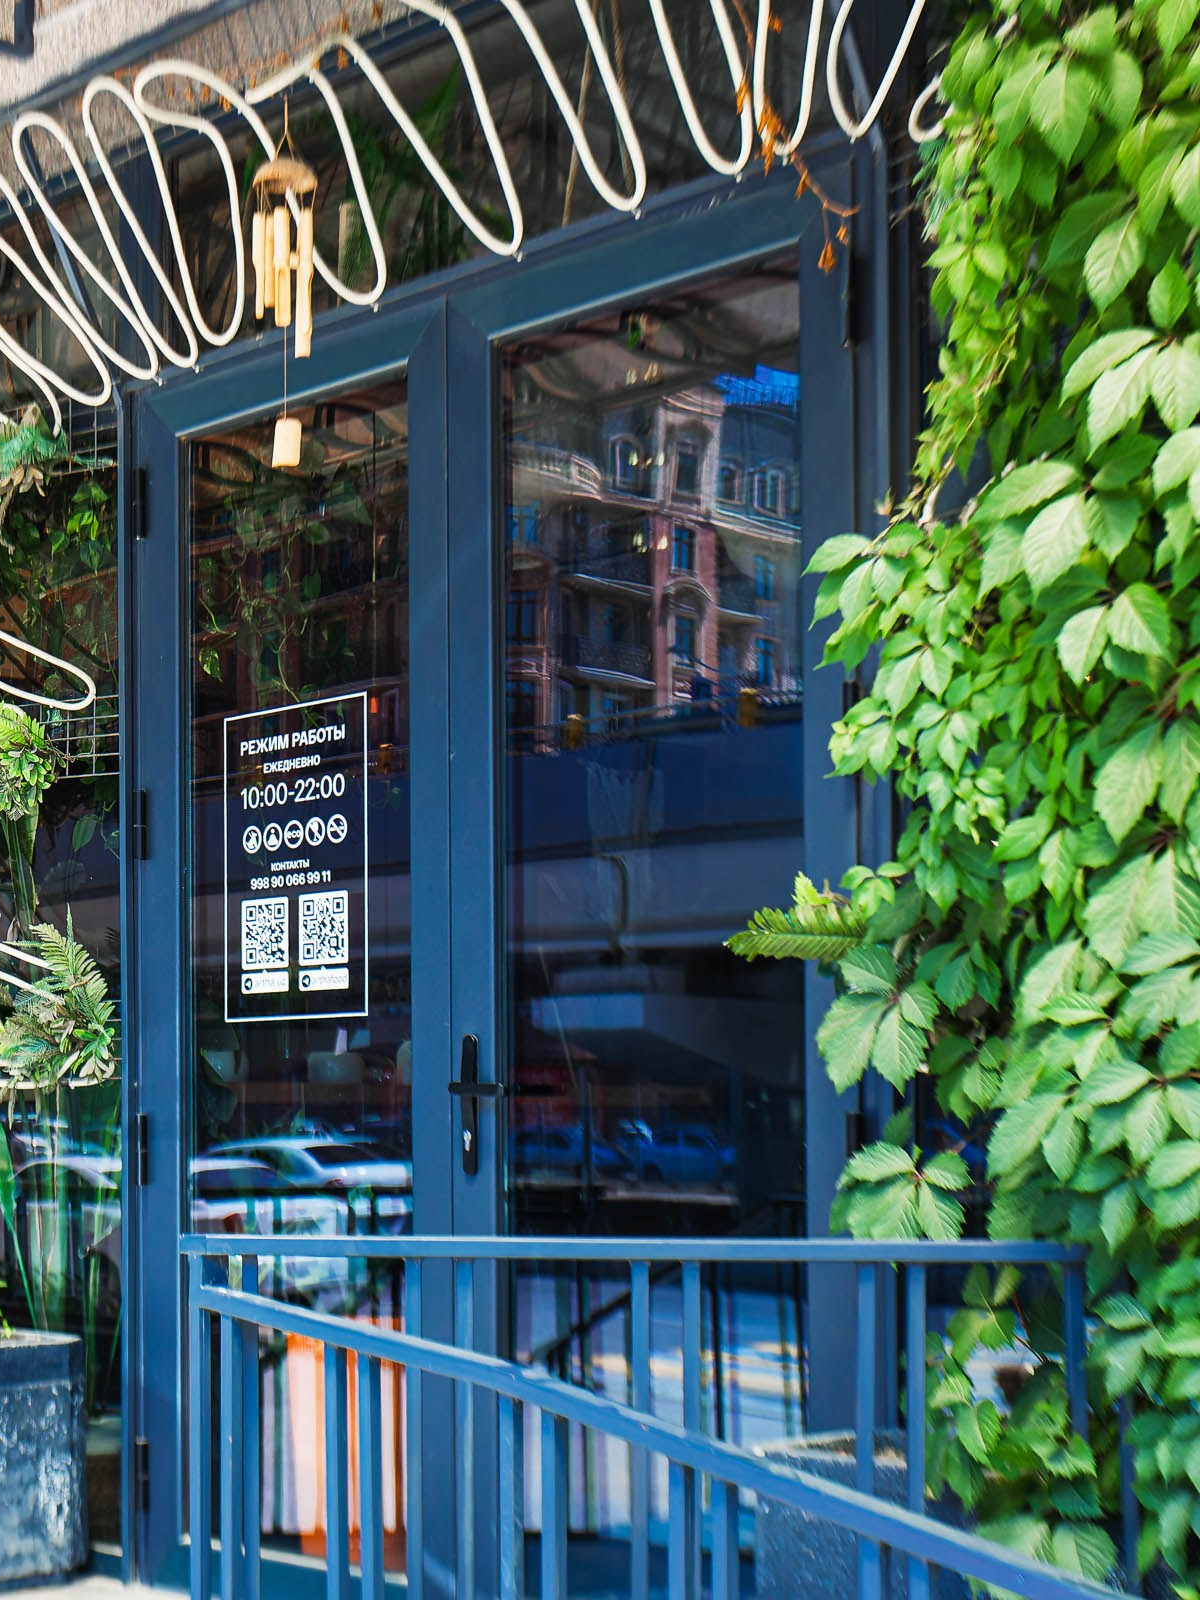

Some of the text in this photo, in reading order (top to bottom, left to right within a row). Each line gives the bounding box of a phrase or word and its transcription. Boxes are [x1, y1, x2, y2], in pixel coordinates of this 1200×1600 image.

[240, 723, 346, 757] РЕЖИМ РАБОТЫ
[263, 754, 321, 774] ЕЖЕДНЕВНО
[240, 772, 346, 810] 10:00-22:00
[287, 829, 301, 839] eco
[270, 859, 310, 872] КОНТАКТЫ
[250, 869, 332, 890] 998 90 066 99 11
